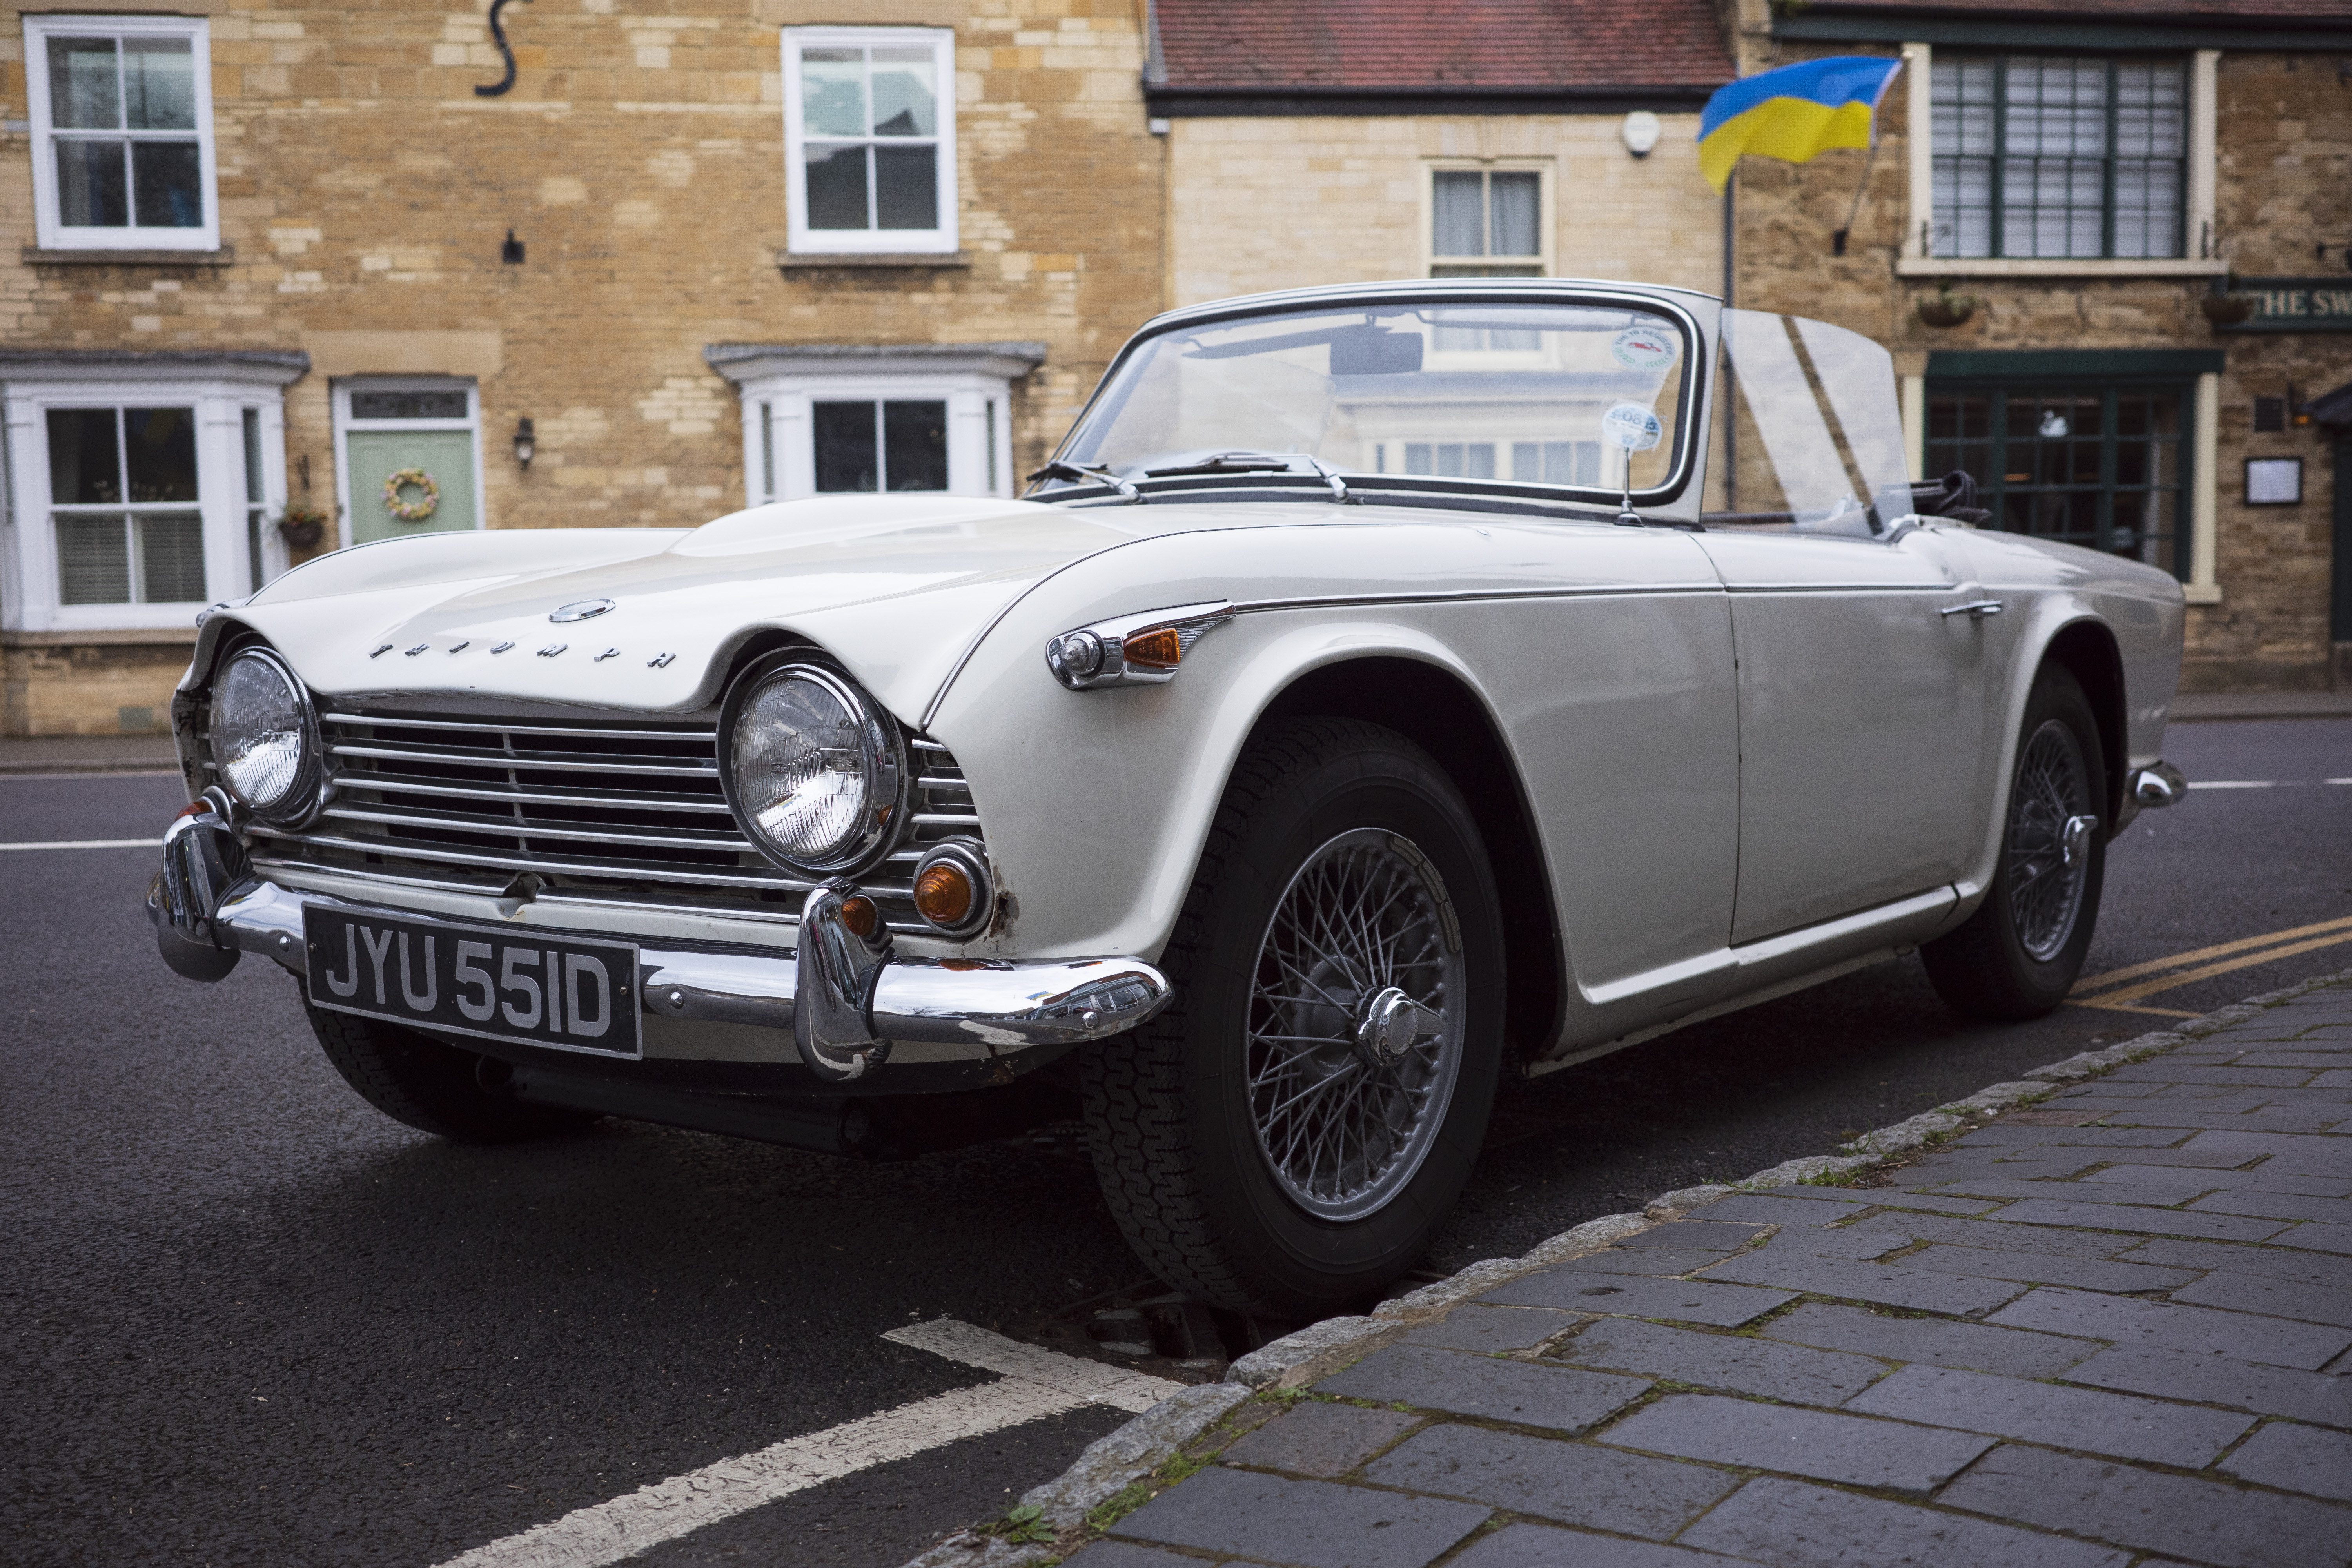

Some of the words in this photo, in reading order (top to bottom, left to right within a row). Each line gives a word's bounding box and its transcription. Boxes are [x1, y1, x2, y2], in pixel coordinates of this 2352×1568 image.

[2247, 290, 2308, 316] THE
[1615, 334, 1627, 345] THE
[1642, 330, 1673, 355] REGISTER
[370, 641, 675, 667] TRIUMPH
[326, 924, 437, 1012] JYU
[456, 940, 611, 1037] 551D
